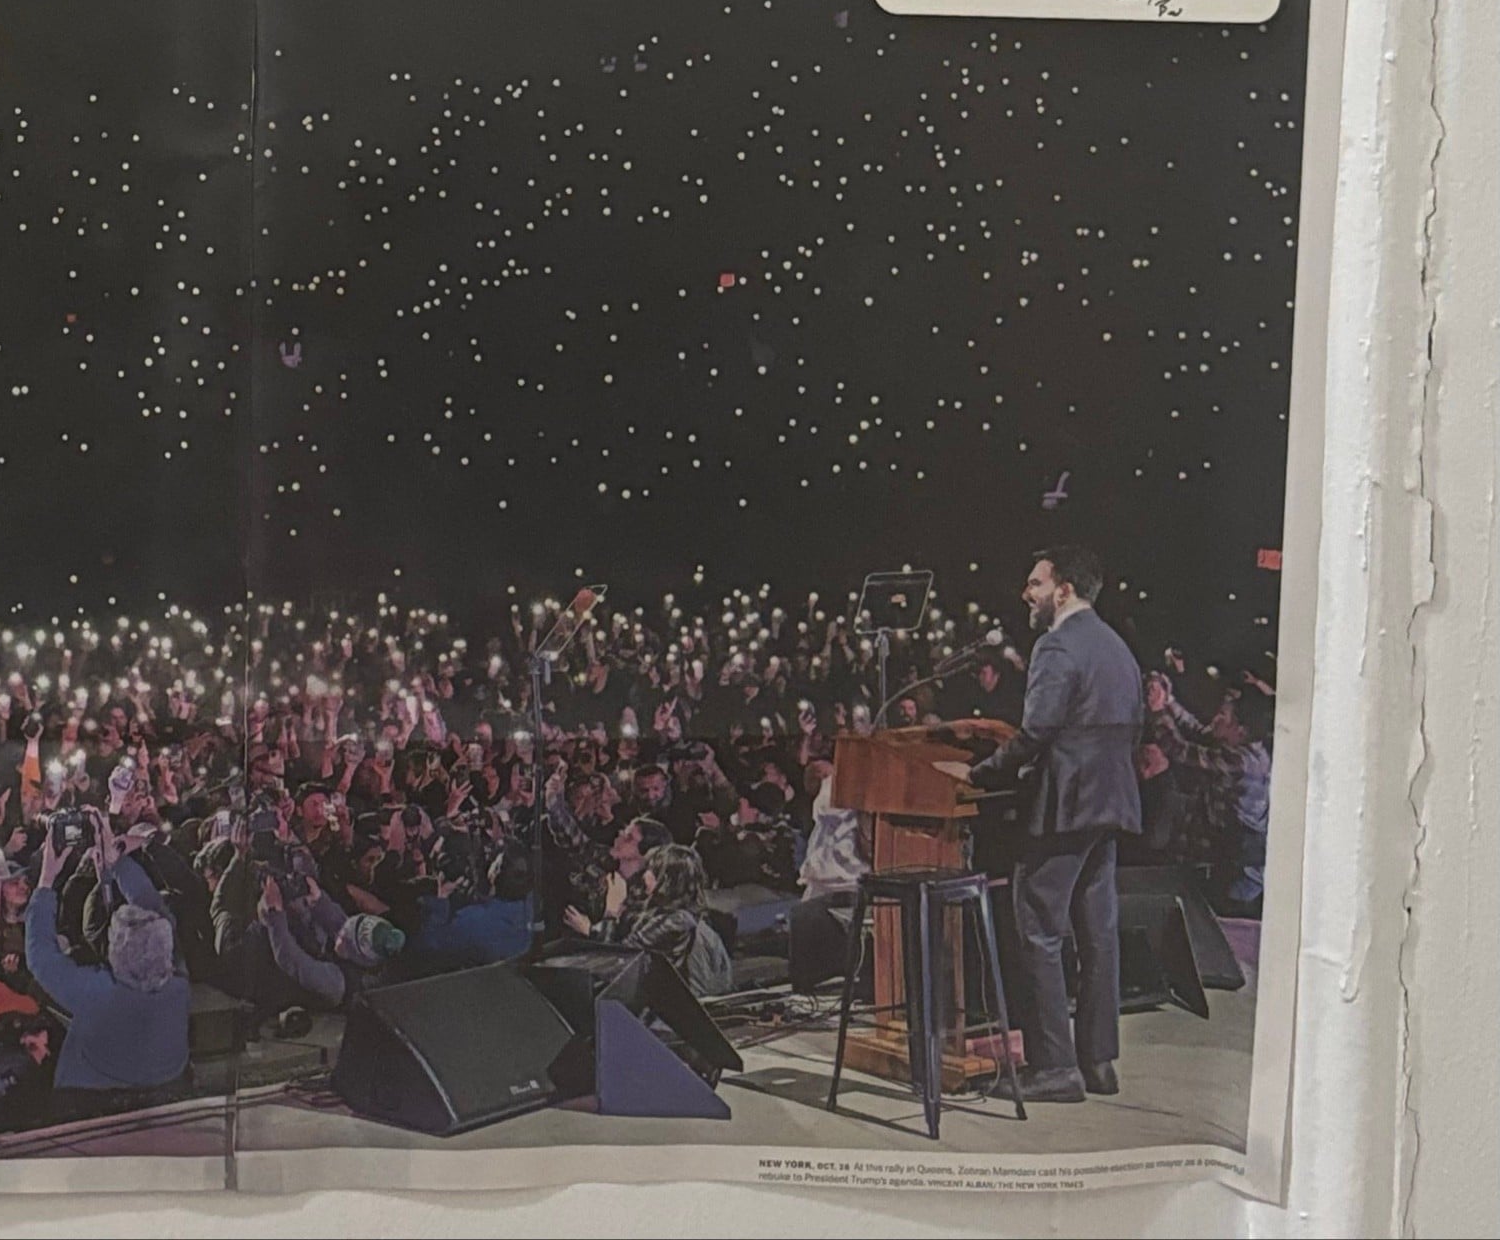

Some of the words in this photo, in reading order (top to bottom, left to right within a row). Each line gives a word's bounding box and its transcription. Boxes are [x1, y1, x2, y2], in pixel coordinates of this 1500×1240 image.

[759, 1159, 782, 1168] NEW
[784, 1160, 815, 1171] YORK,
[817, 1162, 837, 1171] OCT.
[853, 1163, 864, 1172] At
[866, 1162, 883, 1172] this
[884, 1163, 904, 1175] rally
[906, 1164, 916, 1173] in
[917, 1164, 954, 1176] Queens,
[958, 1166, 991, 1176] Zohran
[993, 1165, 1037, 1177] Mamdani
[1038, 1166, 1057, 1177] cast
[1058, 1165, 1072, 1176] his
[1073, 1163, 1108, 1176] possible
[1185, 1158, 1197, 1167] as
[758, 1171, 791, 1182] rebuke
[793, 1172, 803, 1182] to
[804, 1173, 849, 1185] President
[851, 1174, 887, 1187] Trump's
[889, 1177, 927, 1188] agenda.
[1015, 1180, 1035, 1189] NEW
[1036, 1180, 1059, 1189] YORK
[1060, 1180, 1084, 1189] TIMES
